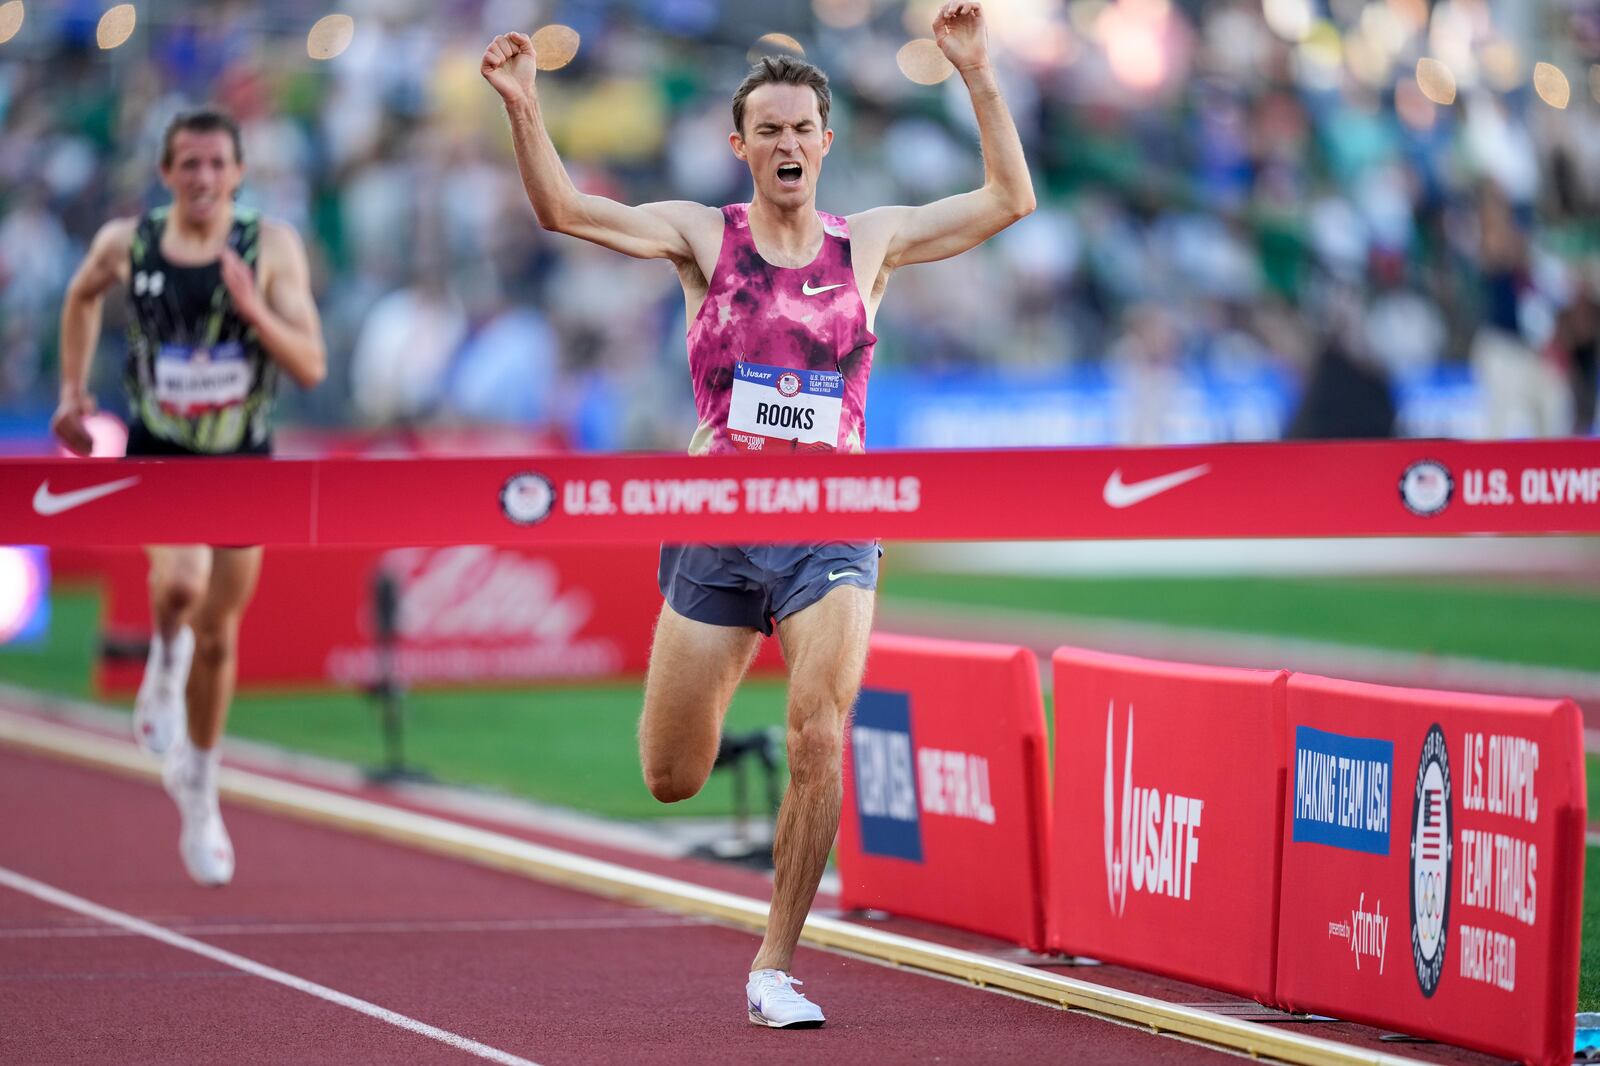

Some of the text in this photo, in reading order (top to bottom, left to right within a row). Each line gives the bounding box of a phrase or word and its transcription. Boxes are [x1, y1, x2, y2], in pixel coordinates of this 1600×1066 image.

[750, 371, 772, 380] USATF
[731, 433, 765, 445] TRACKTOWN
[747, 443, 762, 451] 2024
[756, 402, 815, 430] ROOKS
[563, 479, 617, 515] U.S.
[621, 478, 739, 515] OLYMPIC
[743, 477, 818, 513] TEAM
[822, 476, 920, 512] TRIALS
[1462, 469, 1514, 505] U.S.
[1296, 748, 1389, 833] MAKING TEAM USA
[1416, 732, 1435, 800] UNITED
[1463, 733, 1539, 824] U.S. OLYMPIC
[1131, 787, 1203, 901] USATF
[1461, 829, 1537, 926] TEAM TRIALS
[1351, 892, 1389, 976] xfinity
[1460, 925, 1486, 981] TRACK
[1493, 931, 1517, 992] FIELD
